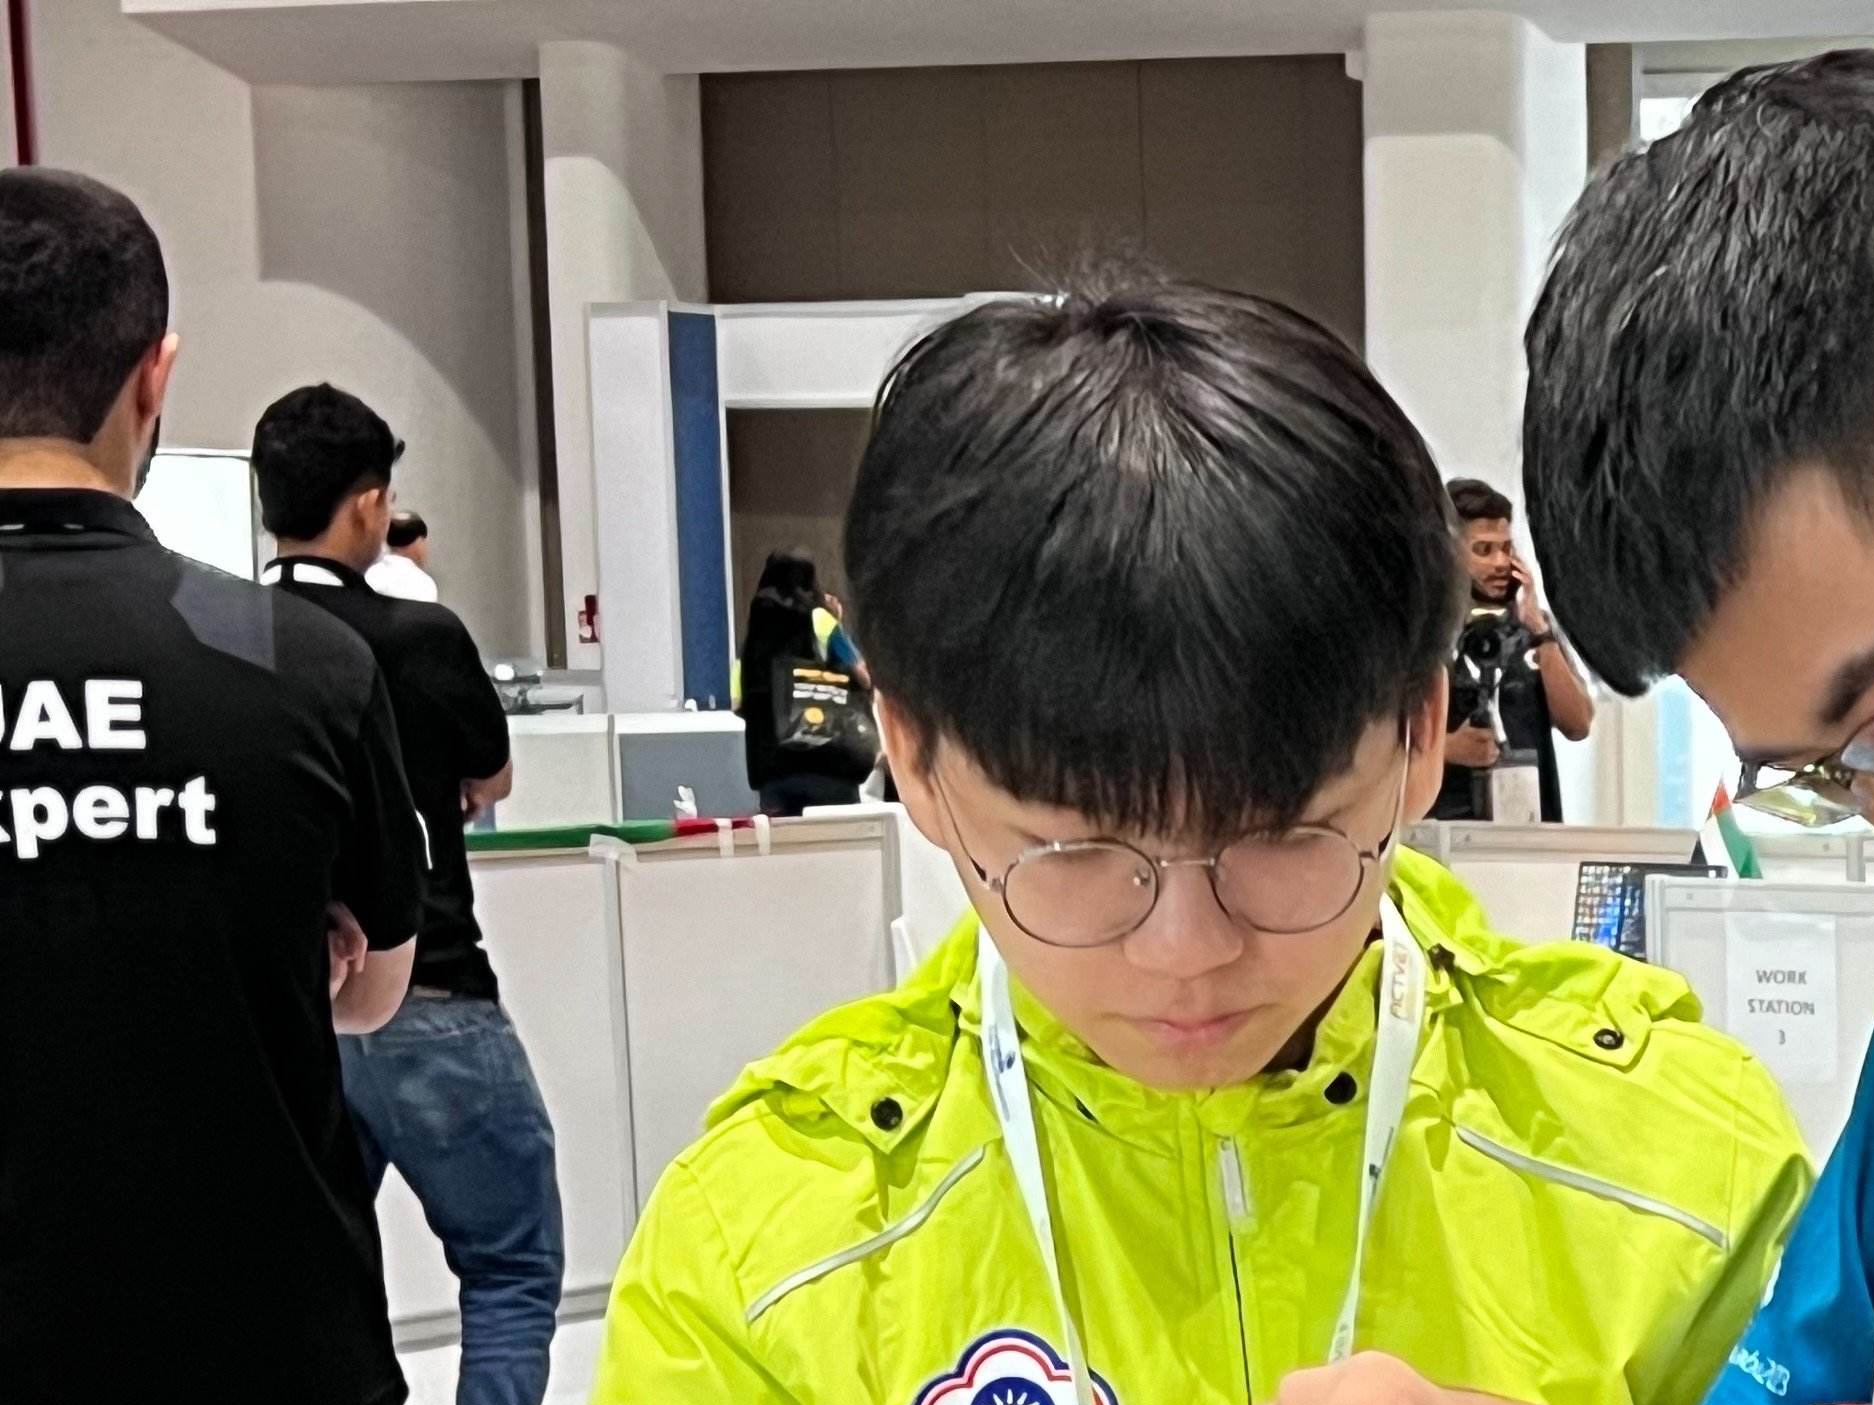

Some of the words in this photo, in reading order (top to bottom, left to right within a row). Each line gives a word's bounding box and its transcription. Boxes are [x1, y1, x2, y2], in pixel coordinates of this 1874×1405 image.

[0, 679, 146, 751] AE
[1756, 969, 1807, 985] WORK
[1747, 998, 1815, 1016] STATION
[1778, 1030, 1786, 1045] 3
